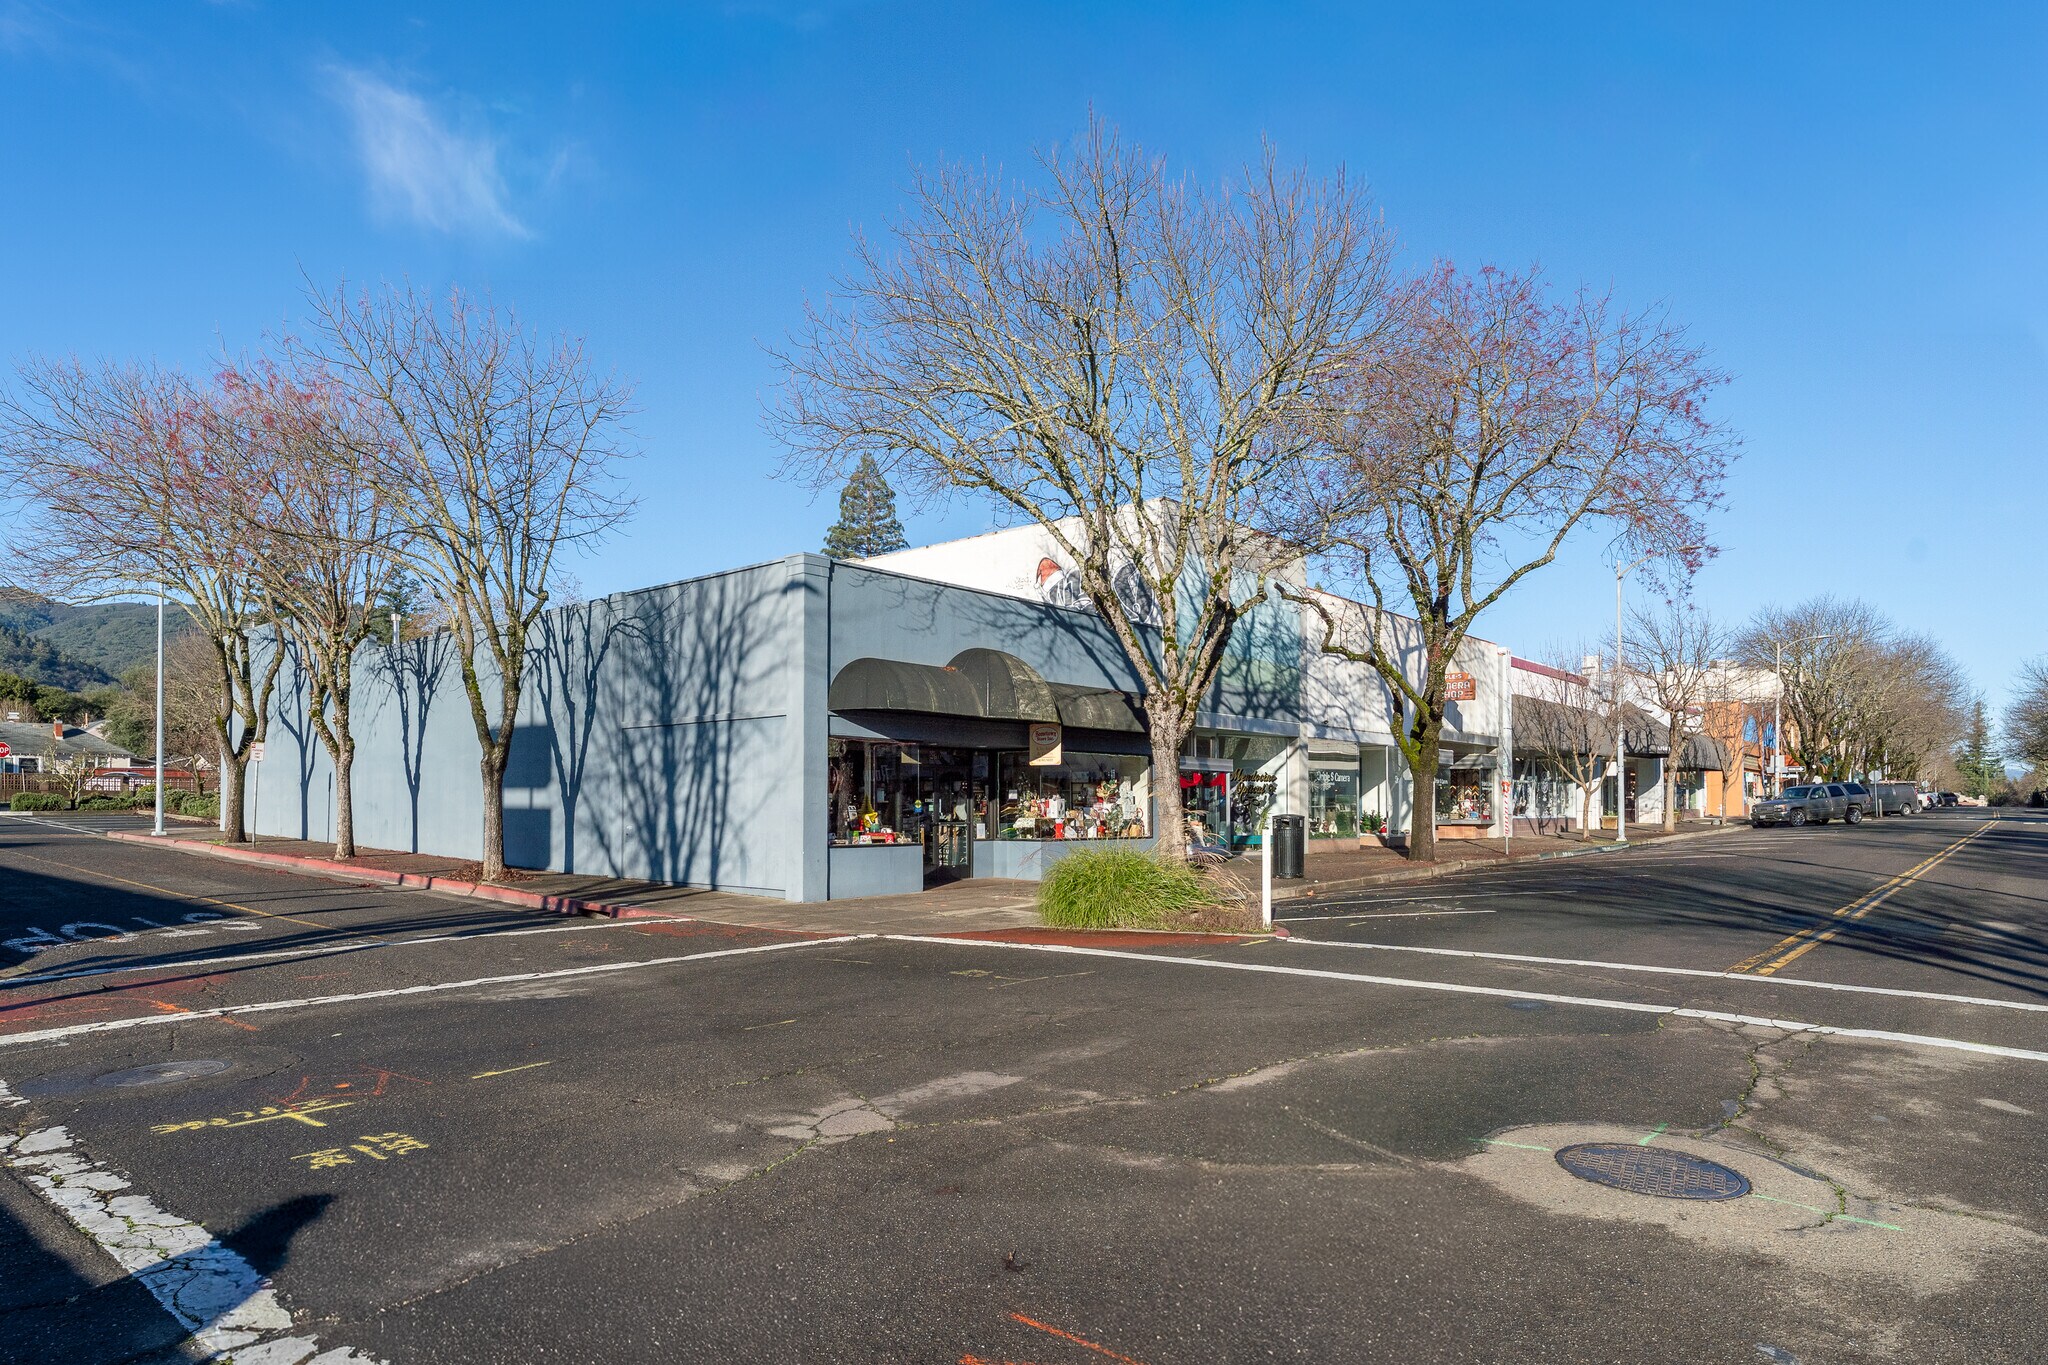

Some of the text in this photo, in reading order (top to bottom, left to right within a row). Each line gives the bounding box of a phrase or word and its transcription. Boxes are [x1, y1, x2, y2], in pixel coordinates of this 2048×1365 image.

[1446, 681, 1470, 690] MERA
[1444, 690, 1463, 698] HOP
[1335, 772, 1351, 782] Camera
